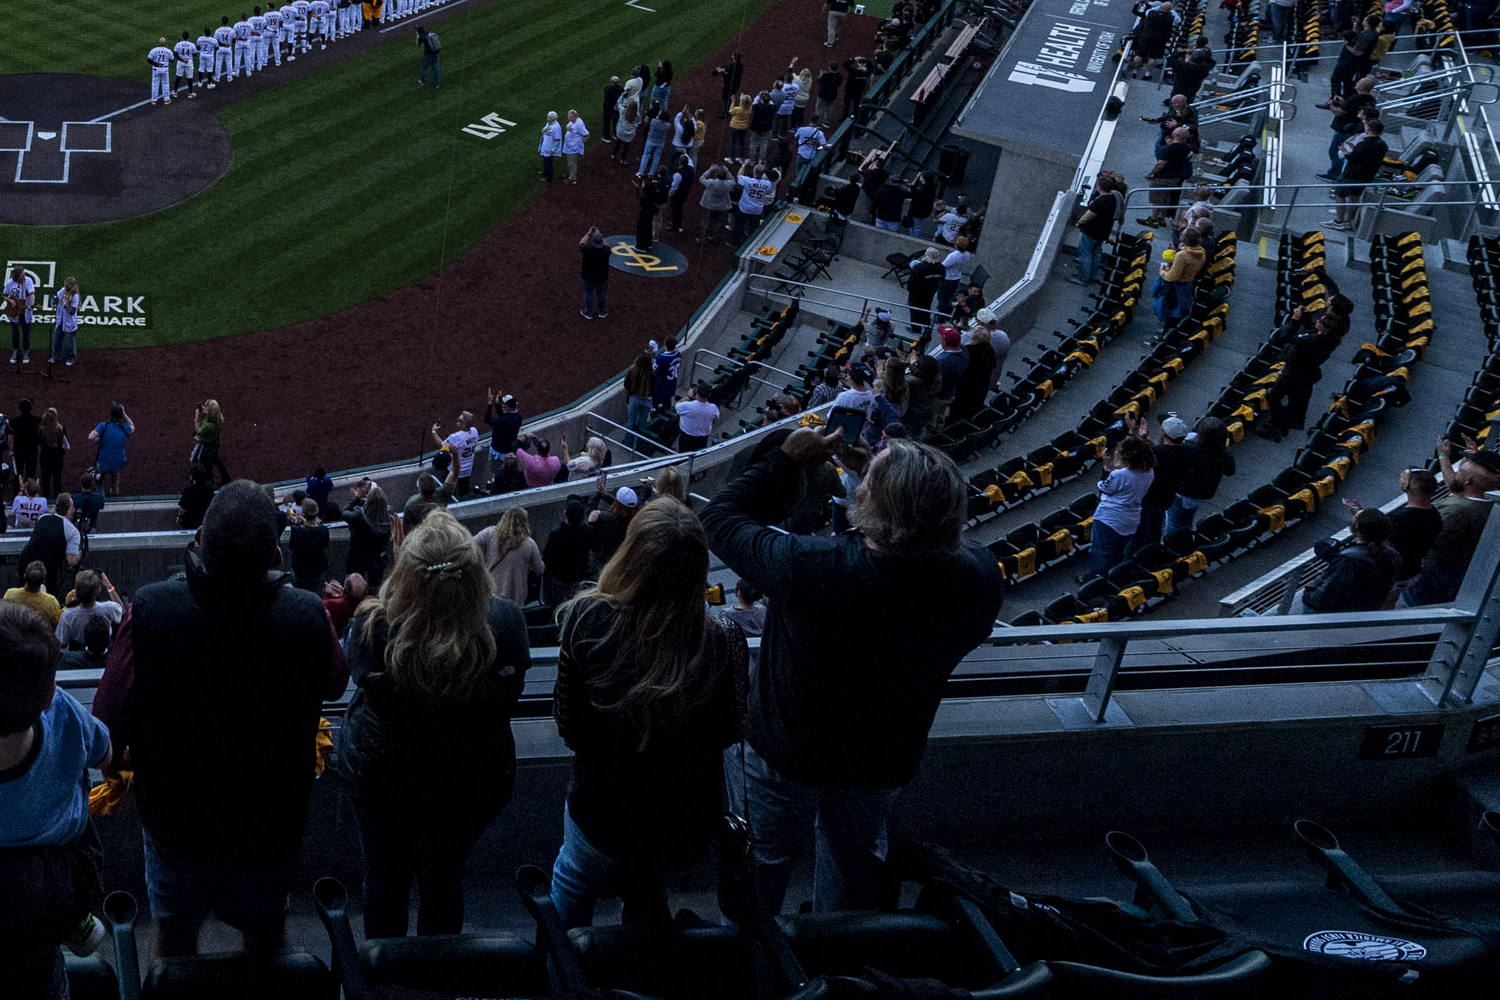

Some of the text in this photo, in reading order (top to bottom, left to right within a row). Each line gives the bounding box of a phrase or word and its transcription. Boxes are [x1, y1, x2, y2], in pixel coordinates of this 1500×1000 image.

[1036, 22, 1091, 68] HEALTH
[180, 48, 190, 56] 44
[461, 112, 517, 140] LVT
[748, 189, 764, 199] 25
[77, 316, 146, 326] SQUARE
[20, 503, 41, 512] MILLER
[1385, 730, 1421, 755] 211
